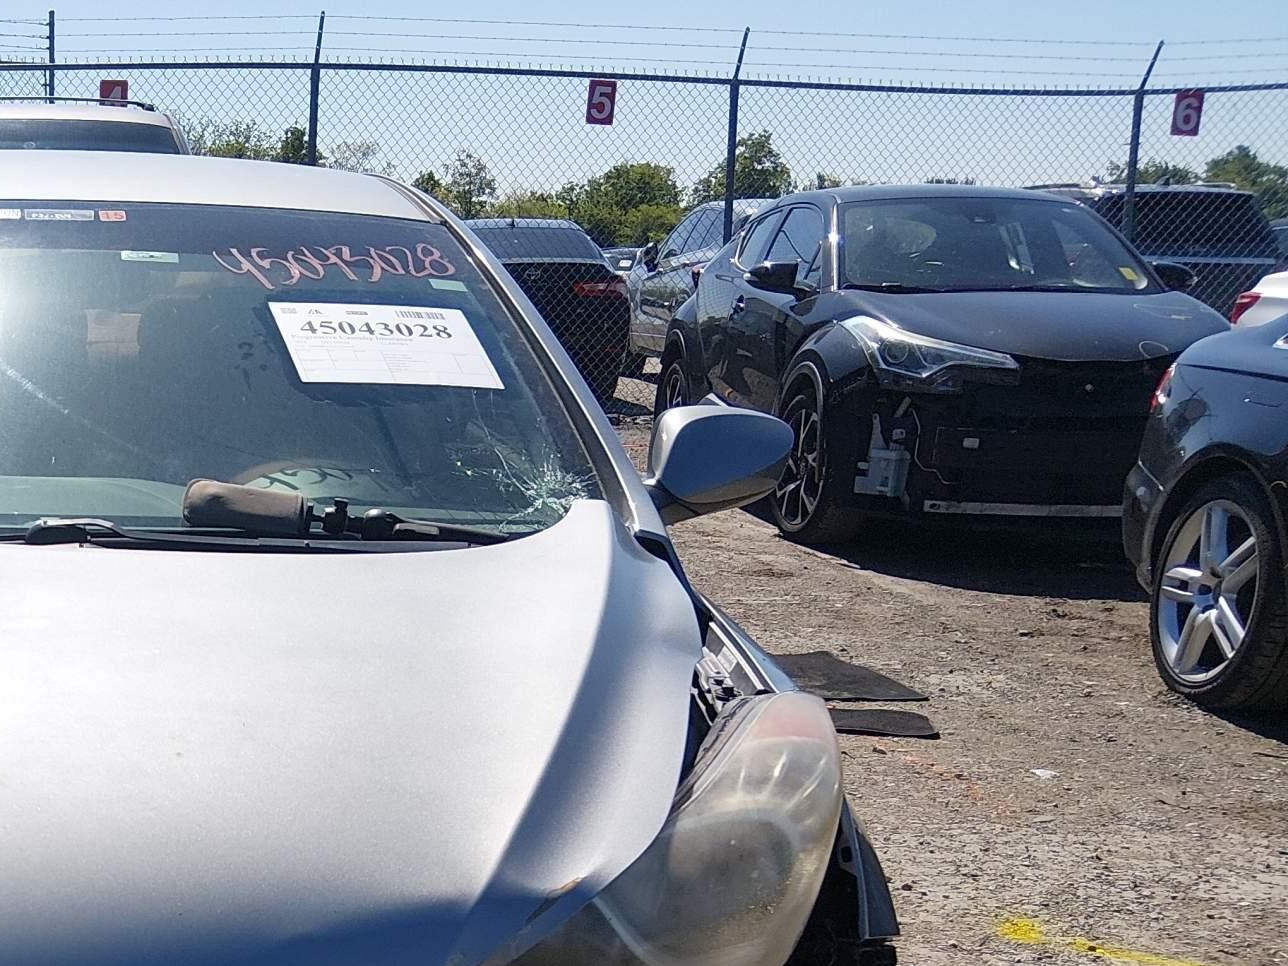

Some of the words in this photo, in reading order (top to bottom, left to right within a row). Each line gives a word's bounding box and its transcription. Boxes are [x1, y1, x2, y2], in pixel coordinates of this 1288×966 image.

[590, 85, 612, 120] 5
[1175, 97, 1200, 131] 6
[212, 243, 456, 289] 45043028
[299, 320, 453, 339] 45043028
